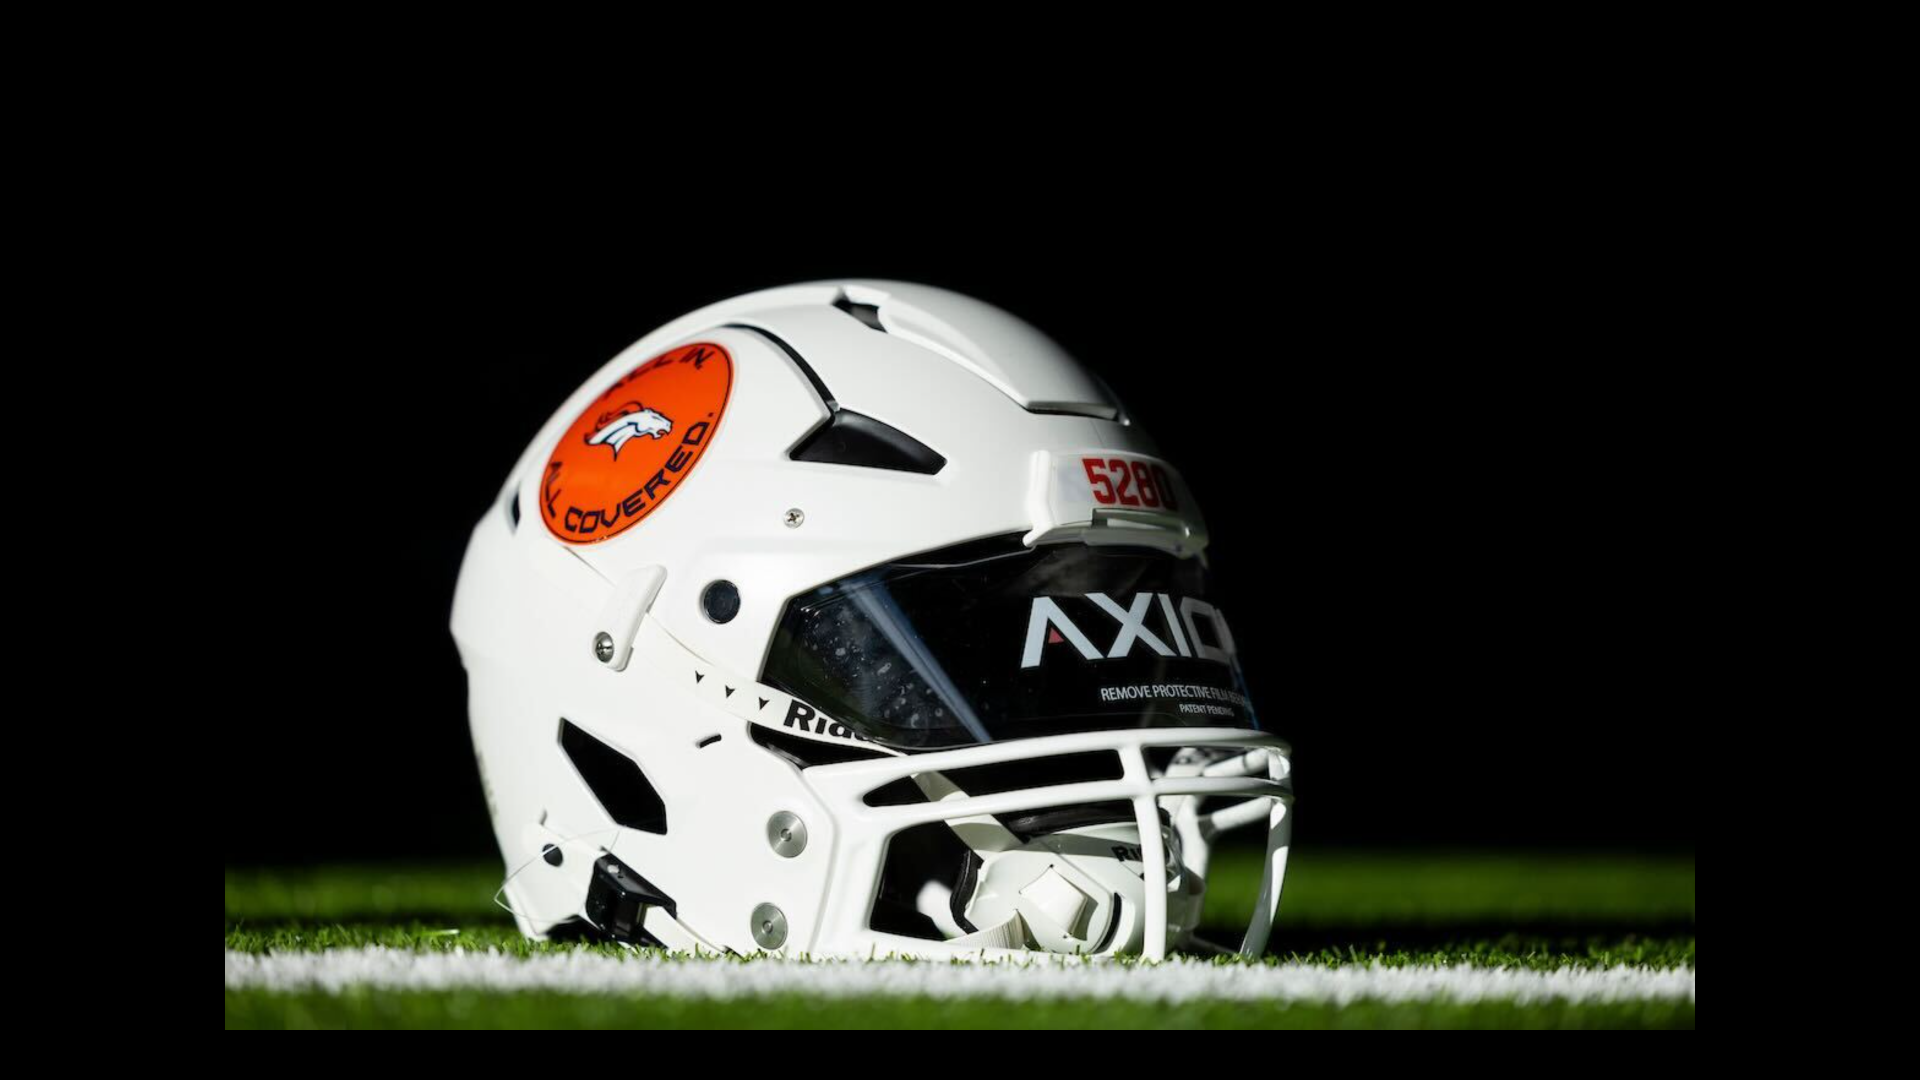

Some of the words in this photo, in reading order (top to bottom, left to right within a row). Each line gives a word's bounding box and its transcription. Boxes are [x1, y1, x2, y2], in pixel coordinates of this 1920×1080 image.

[564, 411, 714, 534] COVERED.
[1082, 458, 1179, 512] 5280
[1021, 592, 1241, 669] AXIO
[1100, 685, 1152, 702] REMOVE
[1152, 684, 1211, 699] PROTECTIVE
[1178, 703, 1207, 714] PATENT
